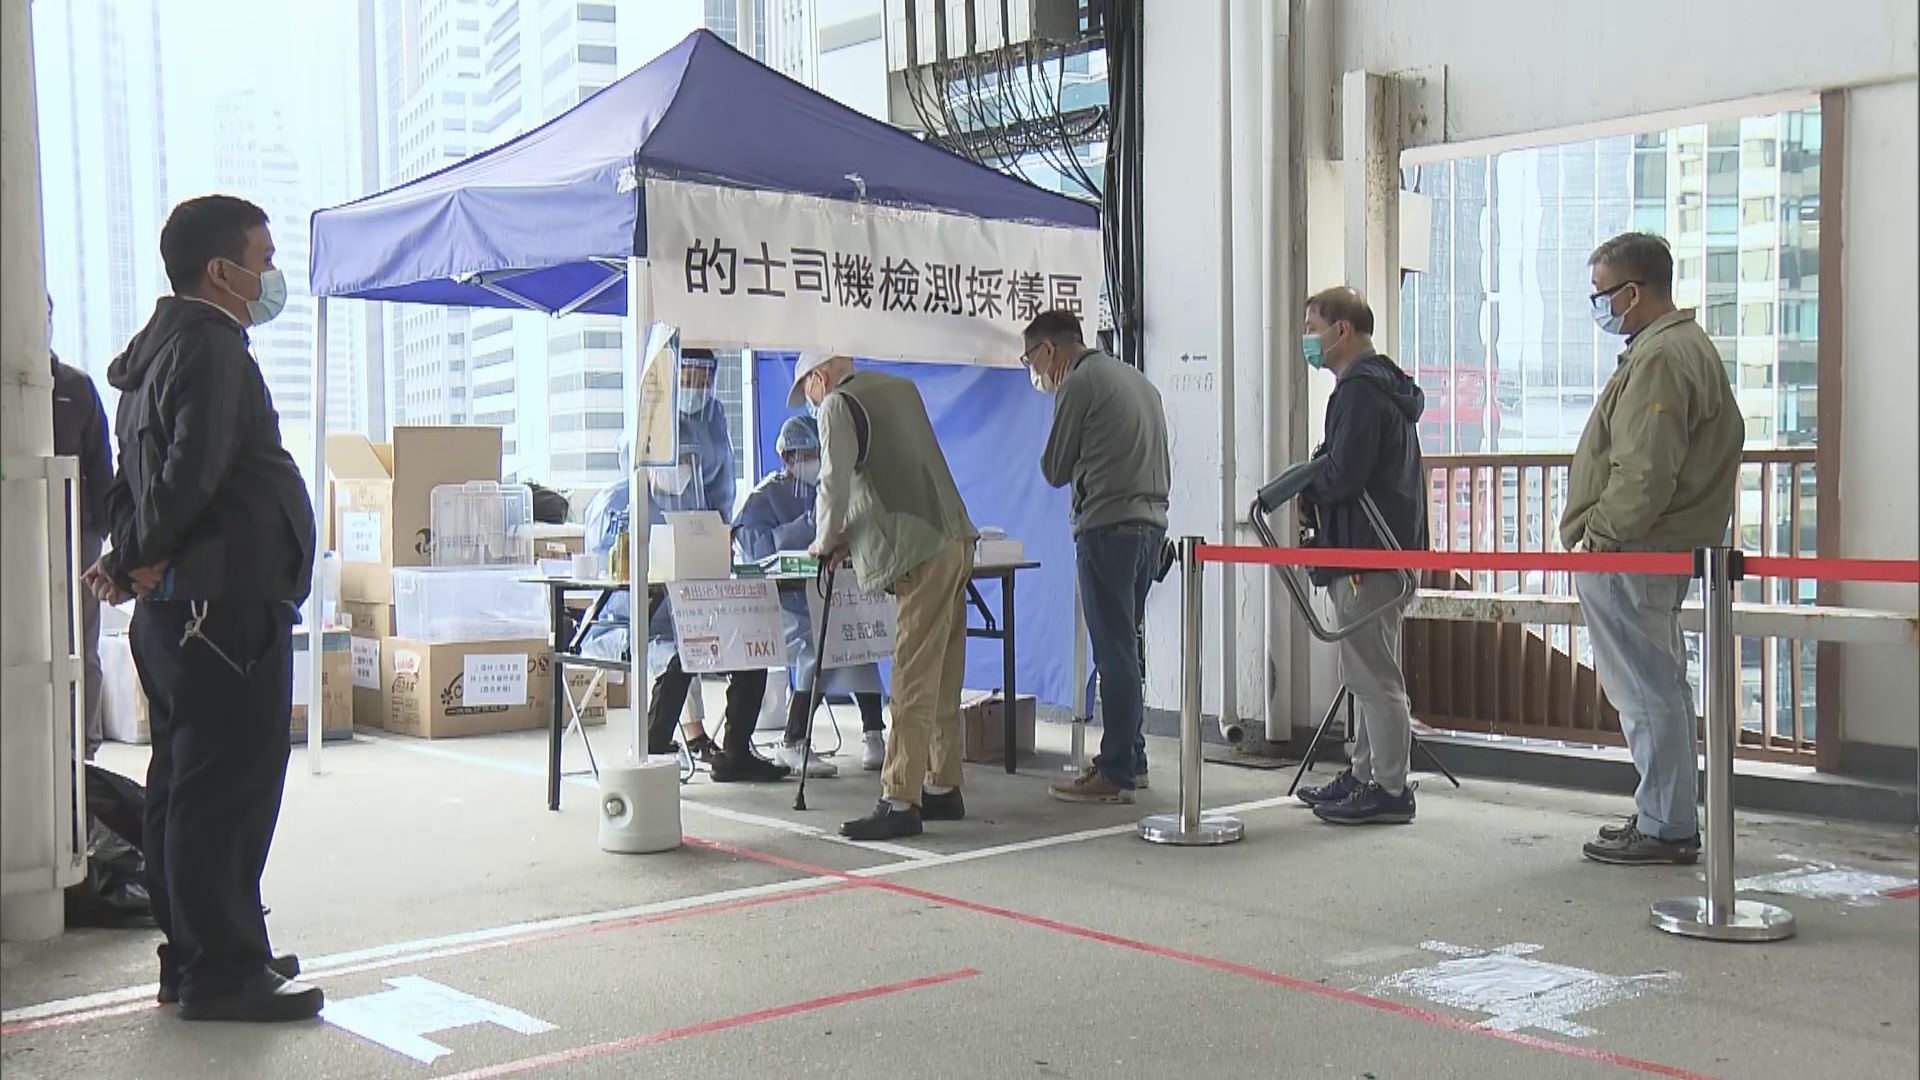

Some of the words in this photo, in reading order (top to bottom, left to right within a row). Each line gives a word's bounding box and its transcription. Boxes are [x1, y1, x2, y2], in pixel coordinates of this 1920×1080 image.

[685, 238, 1084, 321] 的士司機檢測採樣區
[745, 641, 776, 657] TAXI
